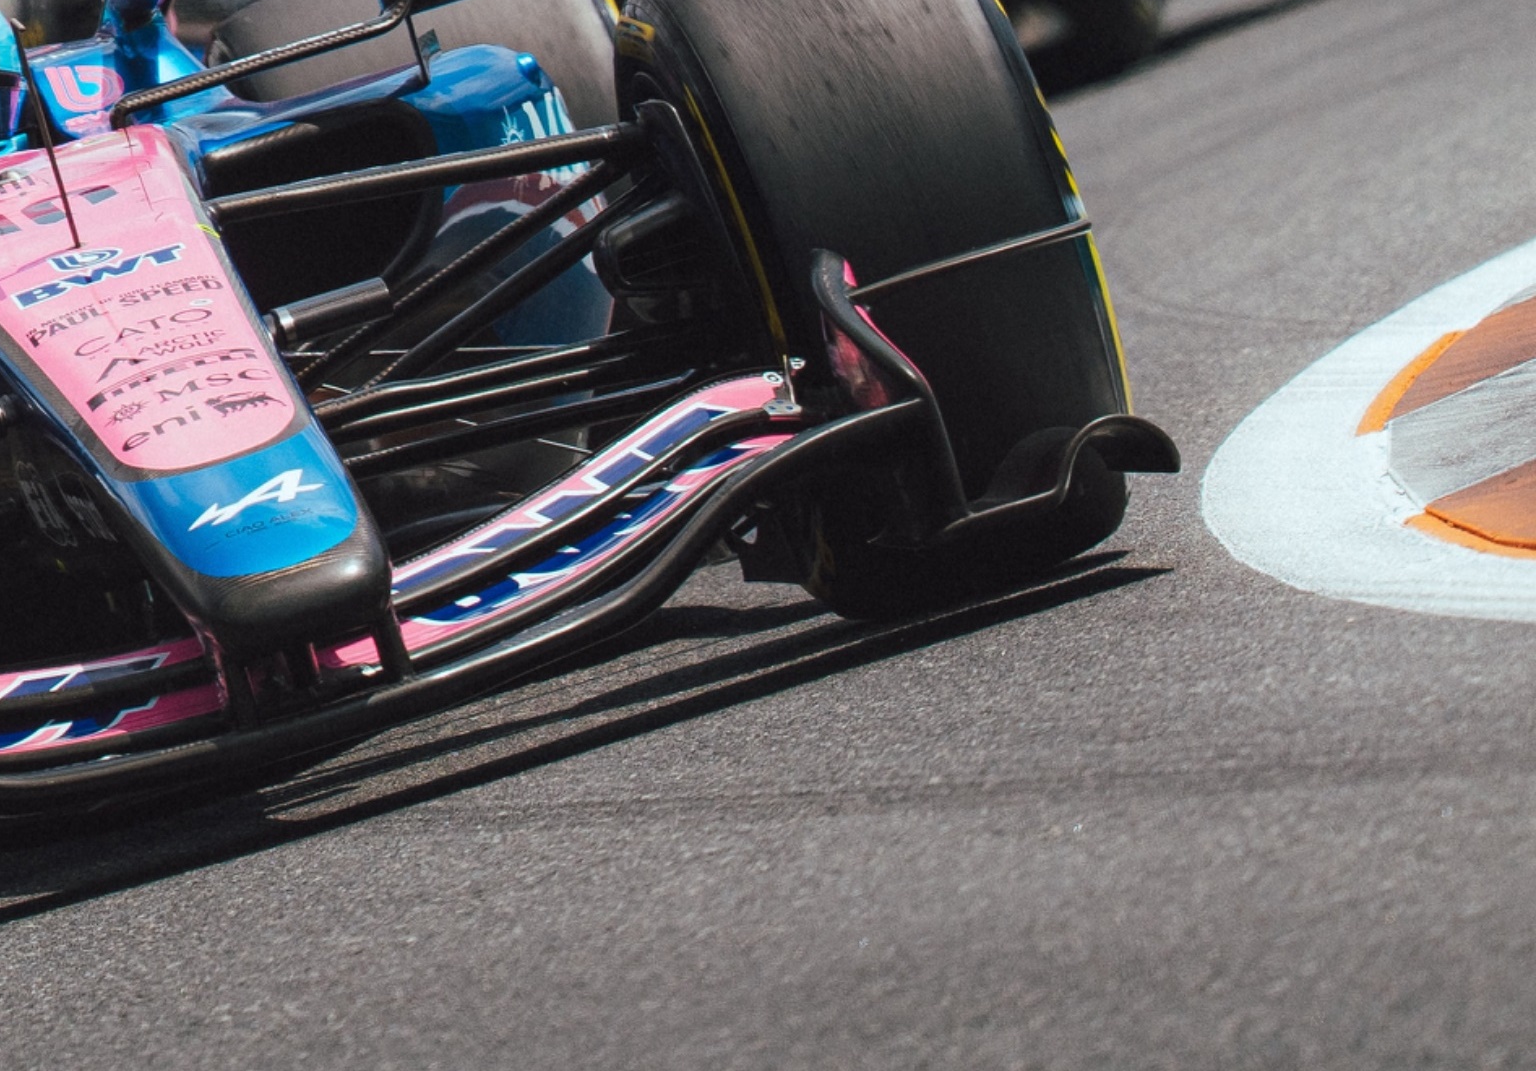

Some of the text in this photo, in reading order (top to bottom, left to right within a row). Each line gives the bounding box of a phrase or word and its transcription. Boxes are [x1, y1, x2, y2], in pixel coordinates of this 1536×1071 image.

[13, 243, 185, 310] BWT
[29, 307, 109, 348] PAUL
[119, 278, 224, 307] SPEED
[74, 308, 213, 357] CATO
[139, 329, 227, 356] ARCTIC
[151, 338, 218, 357] WOLF
[86, 348, 258, 412] PIRELLI
[156, 368, 273, 404] MSC
[122, 405, 203, 452] eni
